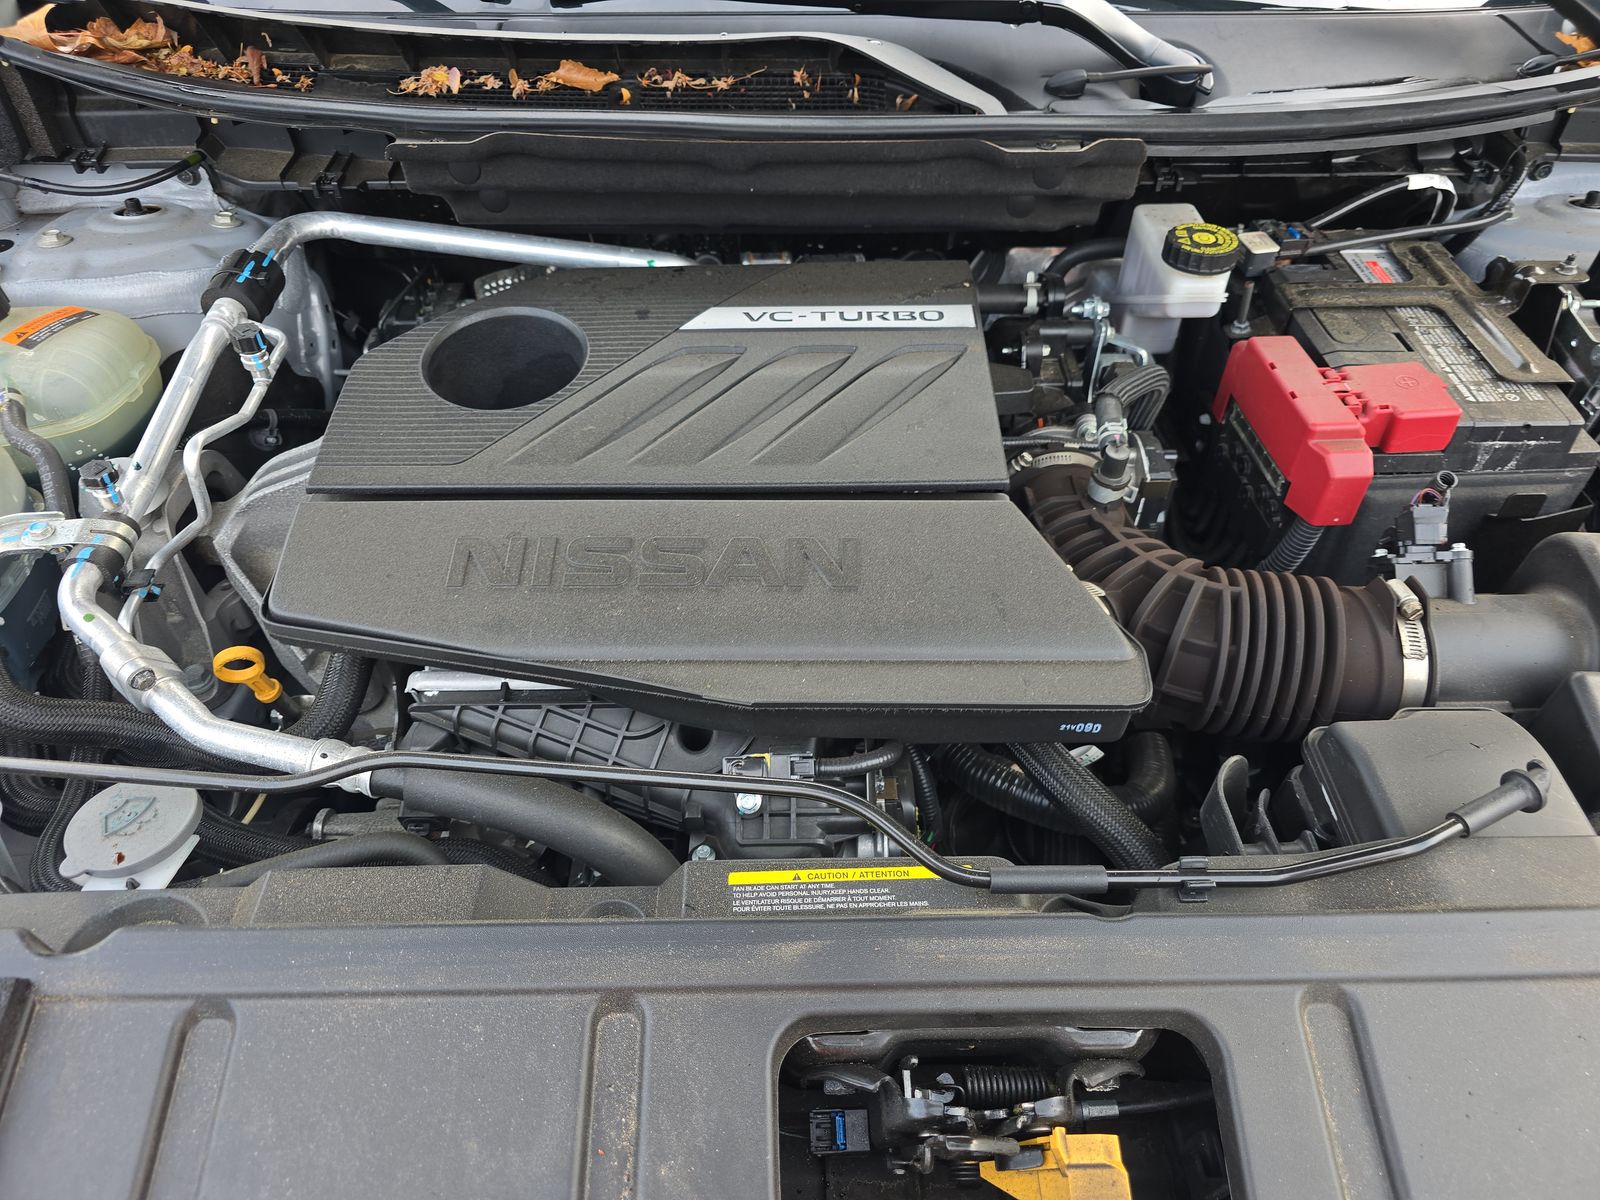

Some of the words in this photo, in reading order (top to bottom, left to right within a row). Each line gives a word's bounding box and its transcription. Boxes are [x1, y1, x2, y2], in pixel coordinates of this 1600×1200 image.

[743, 310, 945, 322] VC-TURBO
[446, 536, 861, 592] NISSAN
[807, 872, 849, 880] CAUTION
[859, 870, 910, 878] ATTENTION
